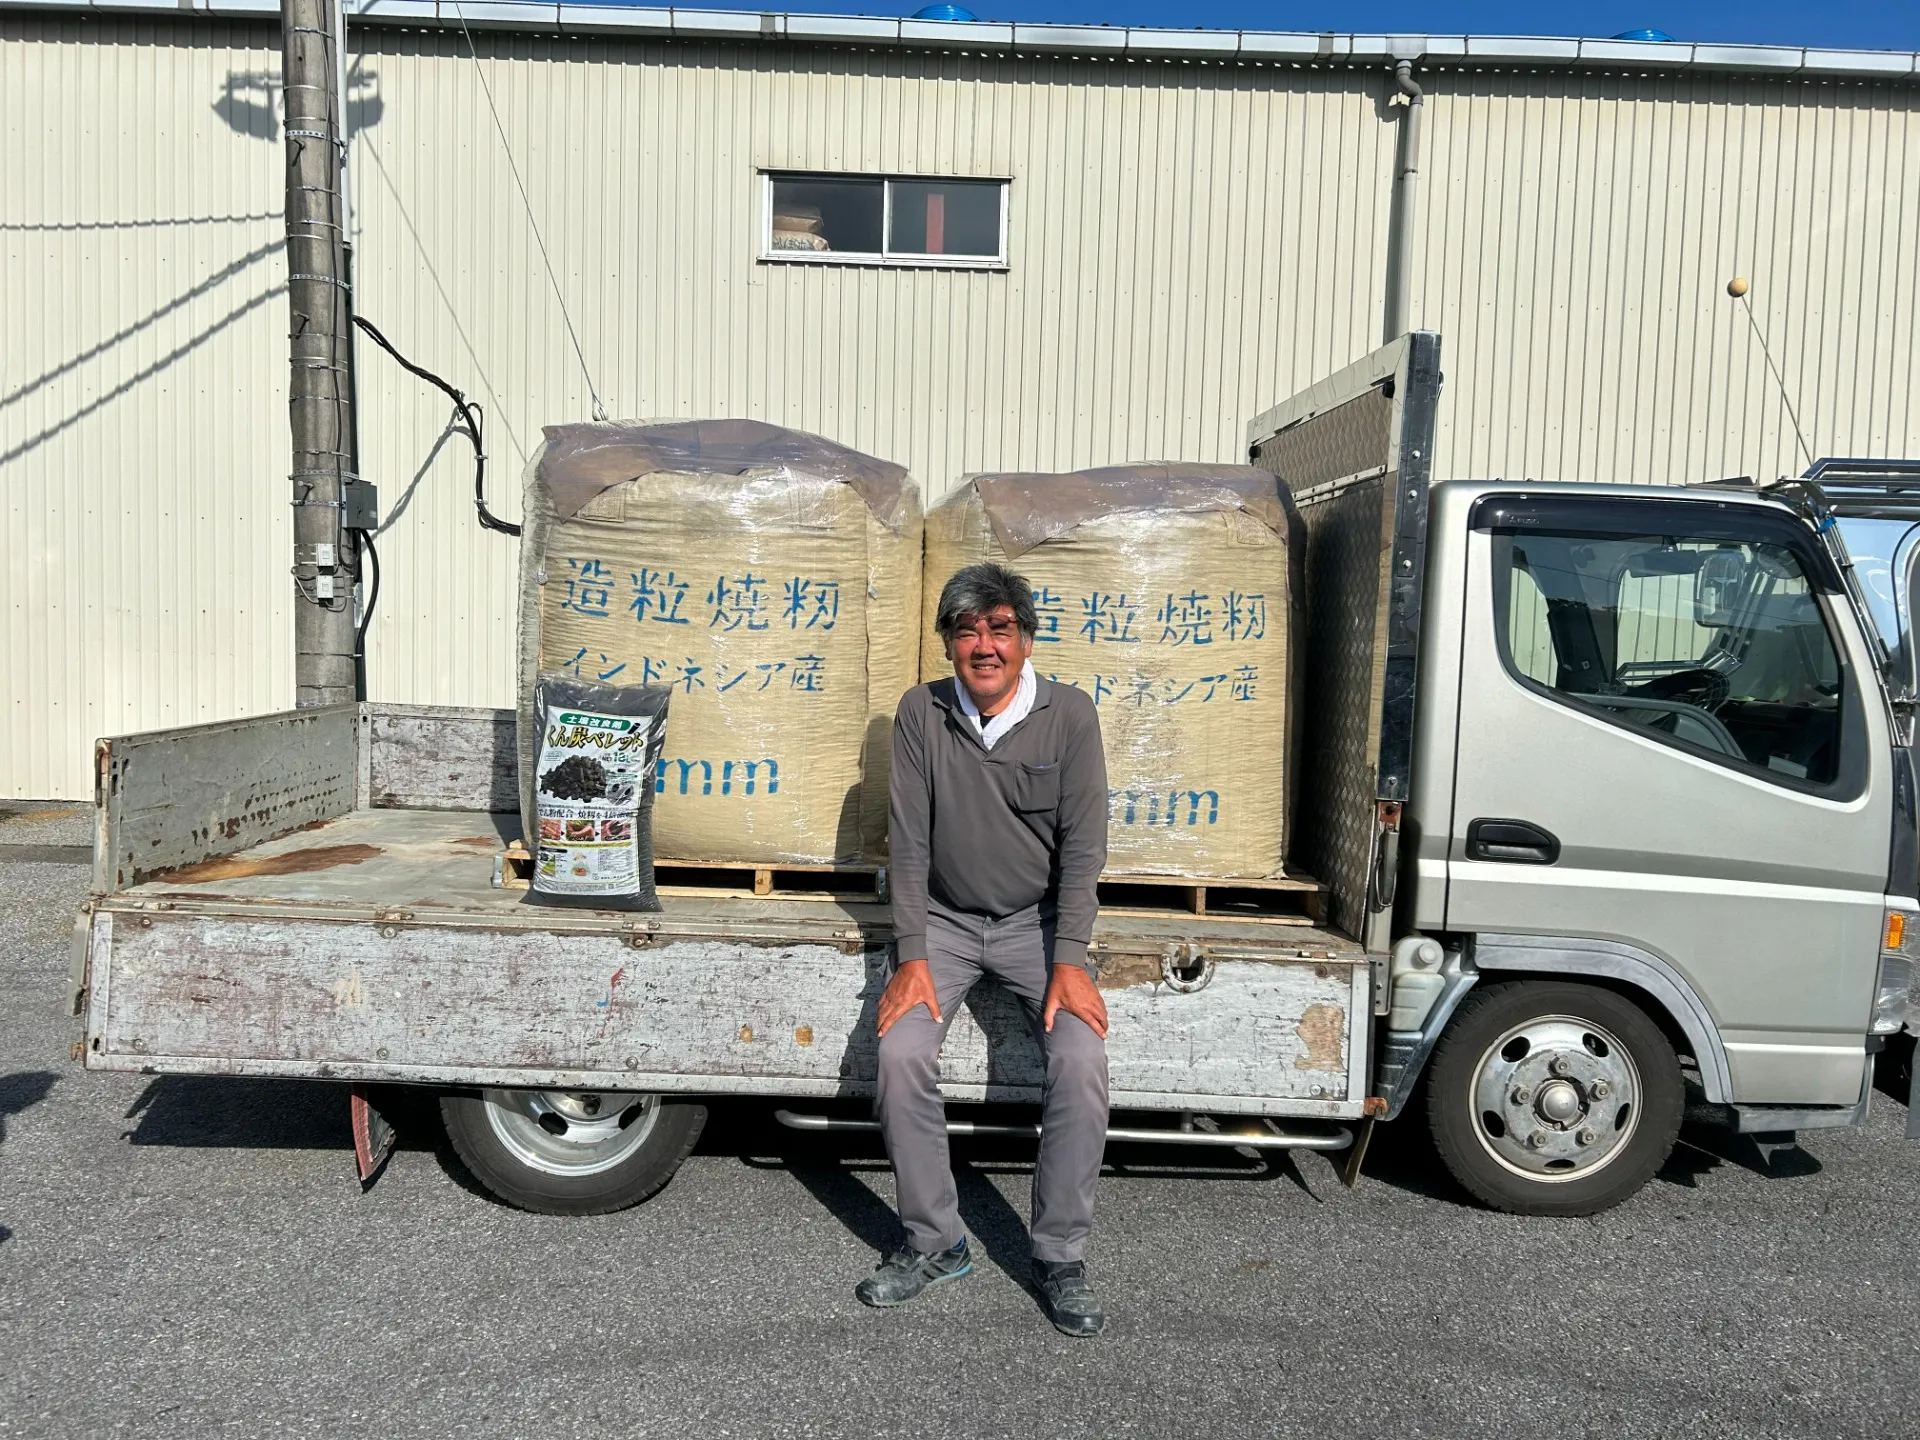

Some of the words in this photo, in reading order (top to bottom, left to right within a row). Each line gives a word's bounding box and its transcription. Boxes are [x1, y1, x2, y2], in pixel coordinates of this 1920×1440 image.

[564, 647, 826, 694] インドネシア産
[566, 715, 623, 730] 土壌改良剤
[547, 726, 644, 752] くん炭ペレット
